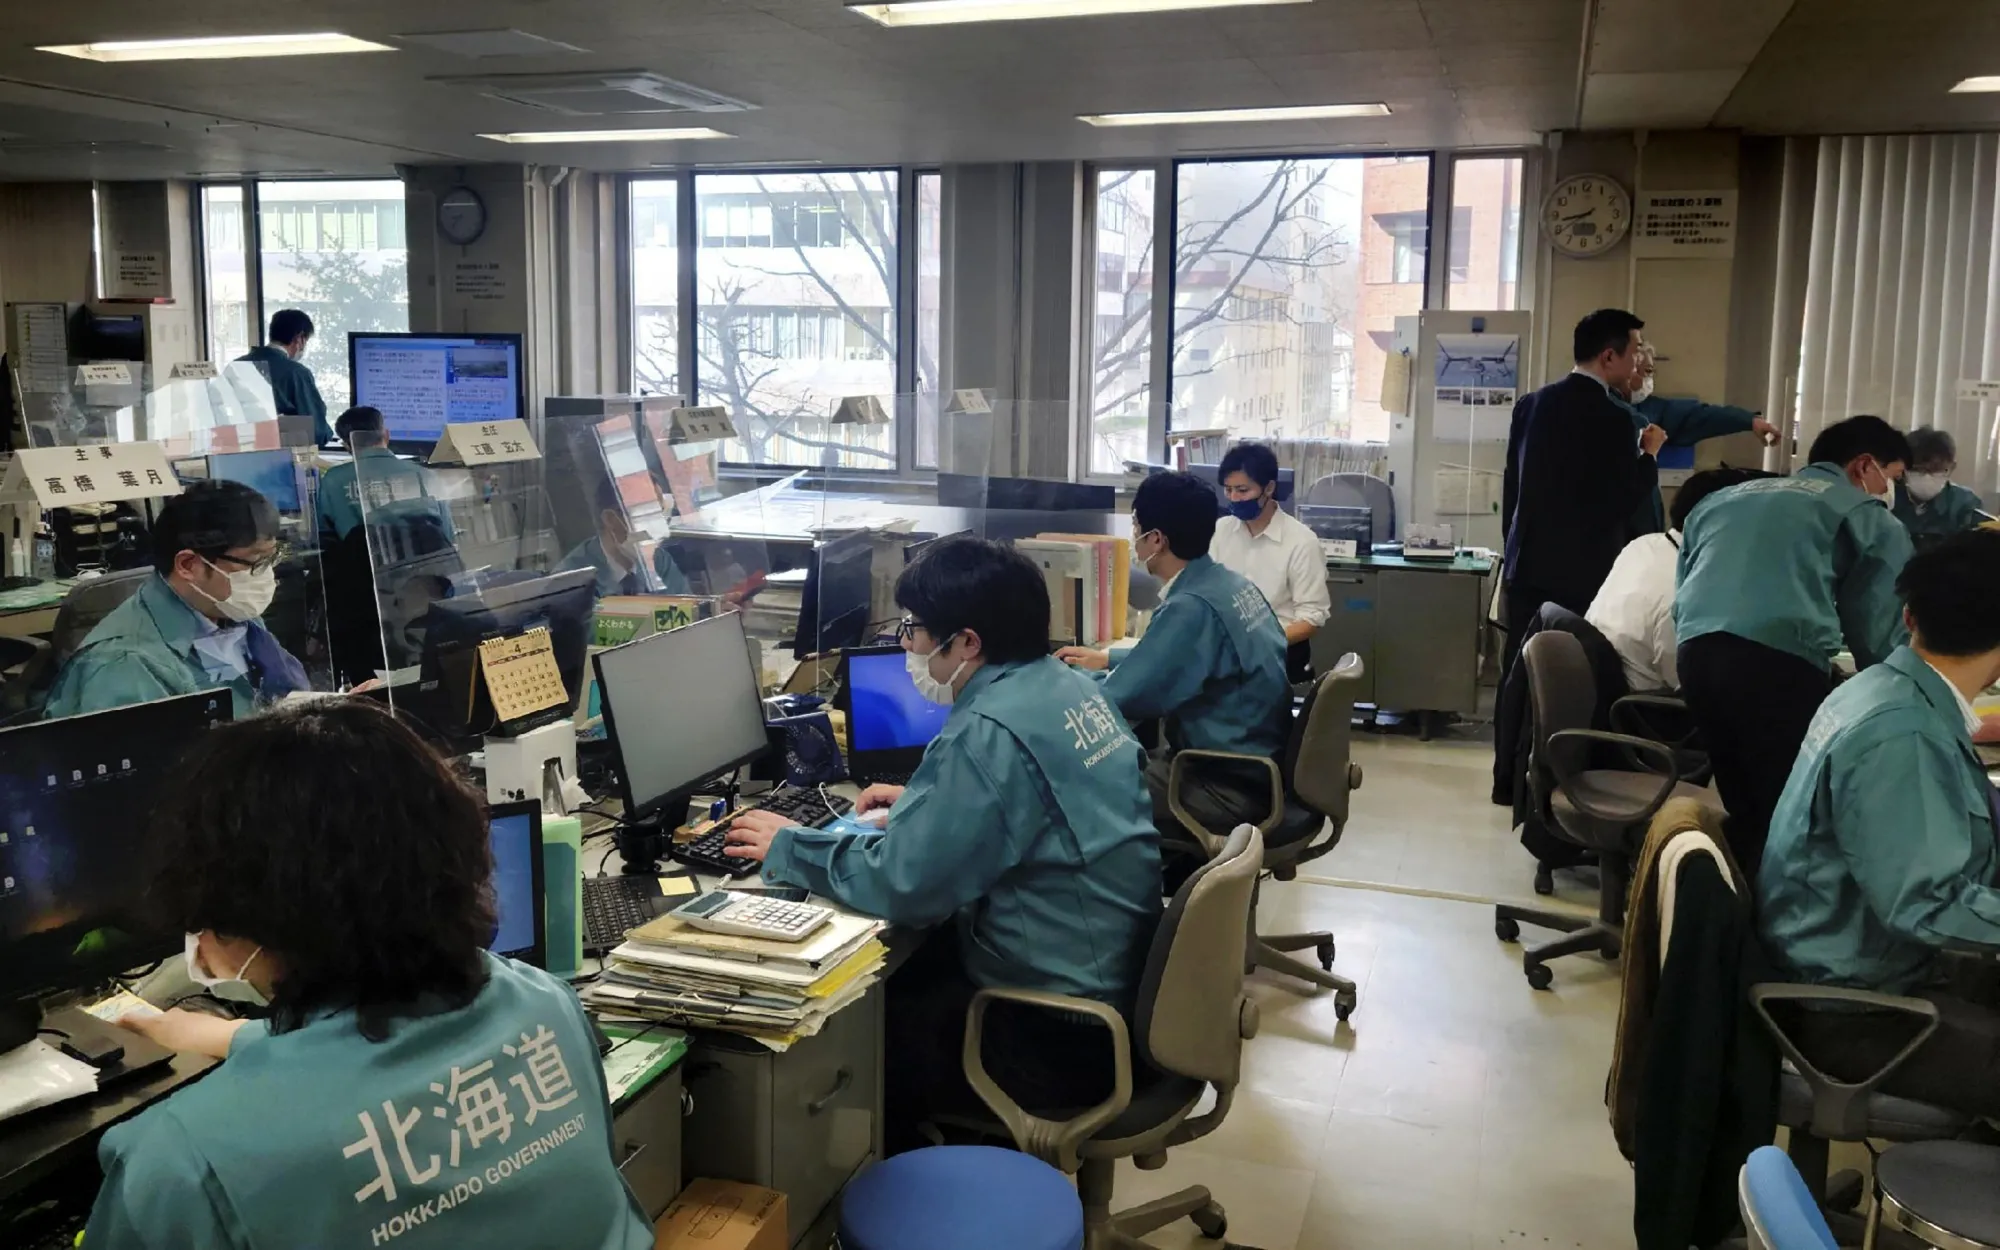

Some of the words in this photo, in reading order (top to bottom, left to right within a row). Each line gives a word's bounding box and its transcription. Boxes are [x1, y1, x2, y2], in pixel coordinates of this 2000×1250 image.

[1568, 186, 1577, 195] 11
[1582, 181, 1592, 192] 12
[1558, 196, 1568, 207] 10
[1608, 195, 1617, 206] 2
[1552, 210, 1560, 219] 9
[1612, 208, 1620, 219] 3
[1555, 224, 1562, 235] 8
[1605, 223, 1614, 233] 4
[1566, 234, 1573, 245] 7
[1580, 237, 1587, 248] 6
[1595, 234, 1603, 245] 5
[45, 474, 96, 494] 高橋
[117, 469, 163, 487] 葉月
[598, 619, 635, 630] よくわかる
[514, 643, 521, 653] 4
[342, 1024, 579, 1203] 北海道
[371, 1176, 484, 1247] HOKKAIDO
[485, 1112, 587, 1185] GOVERNMENT
